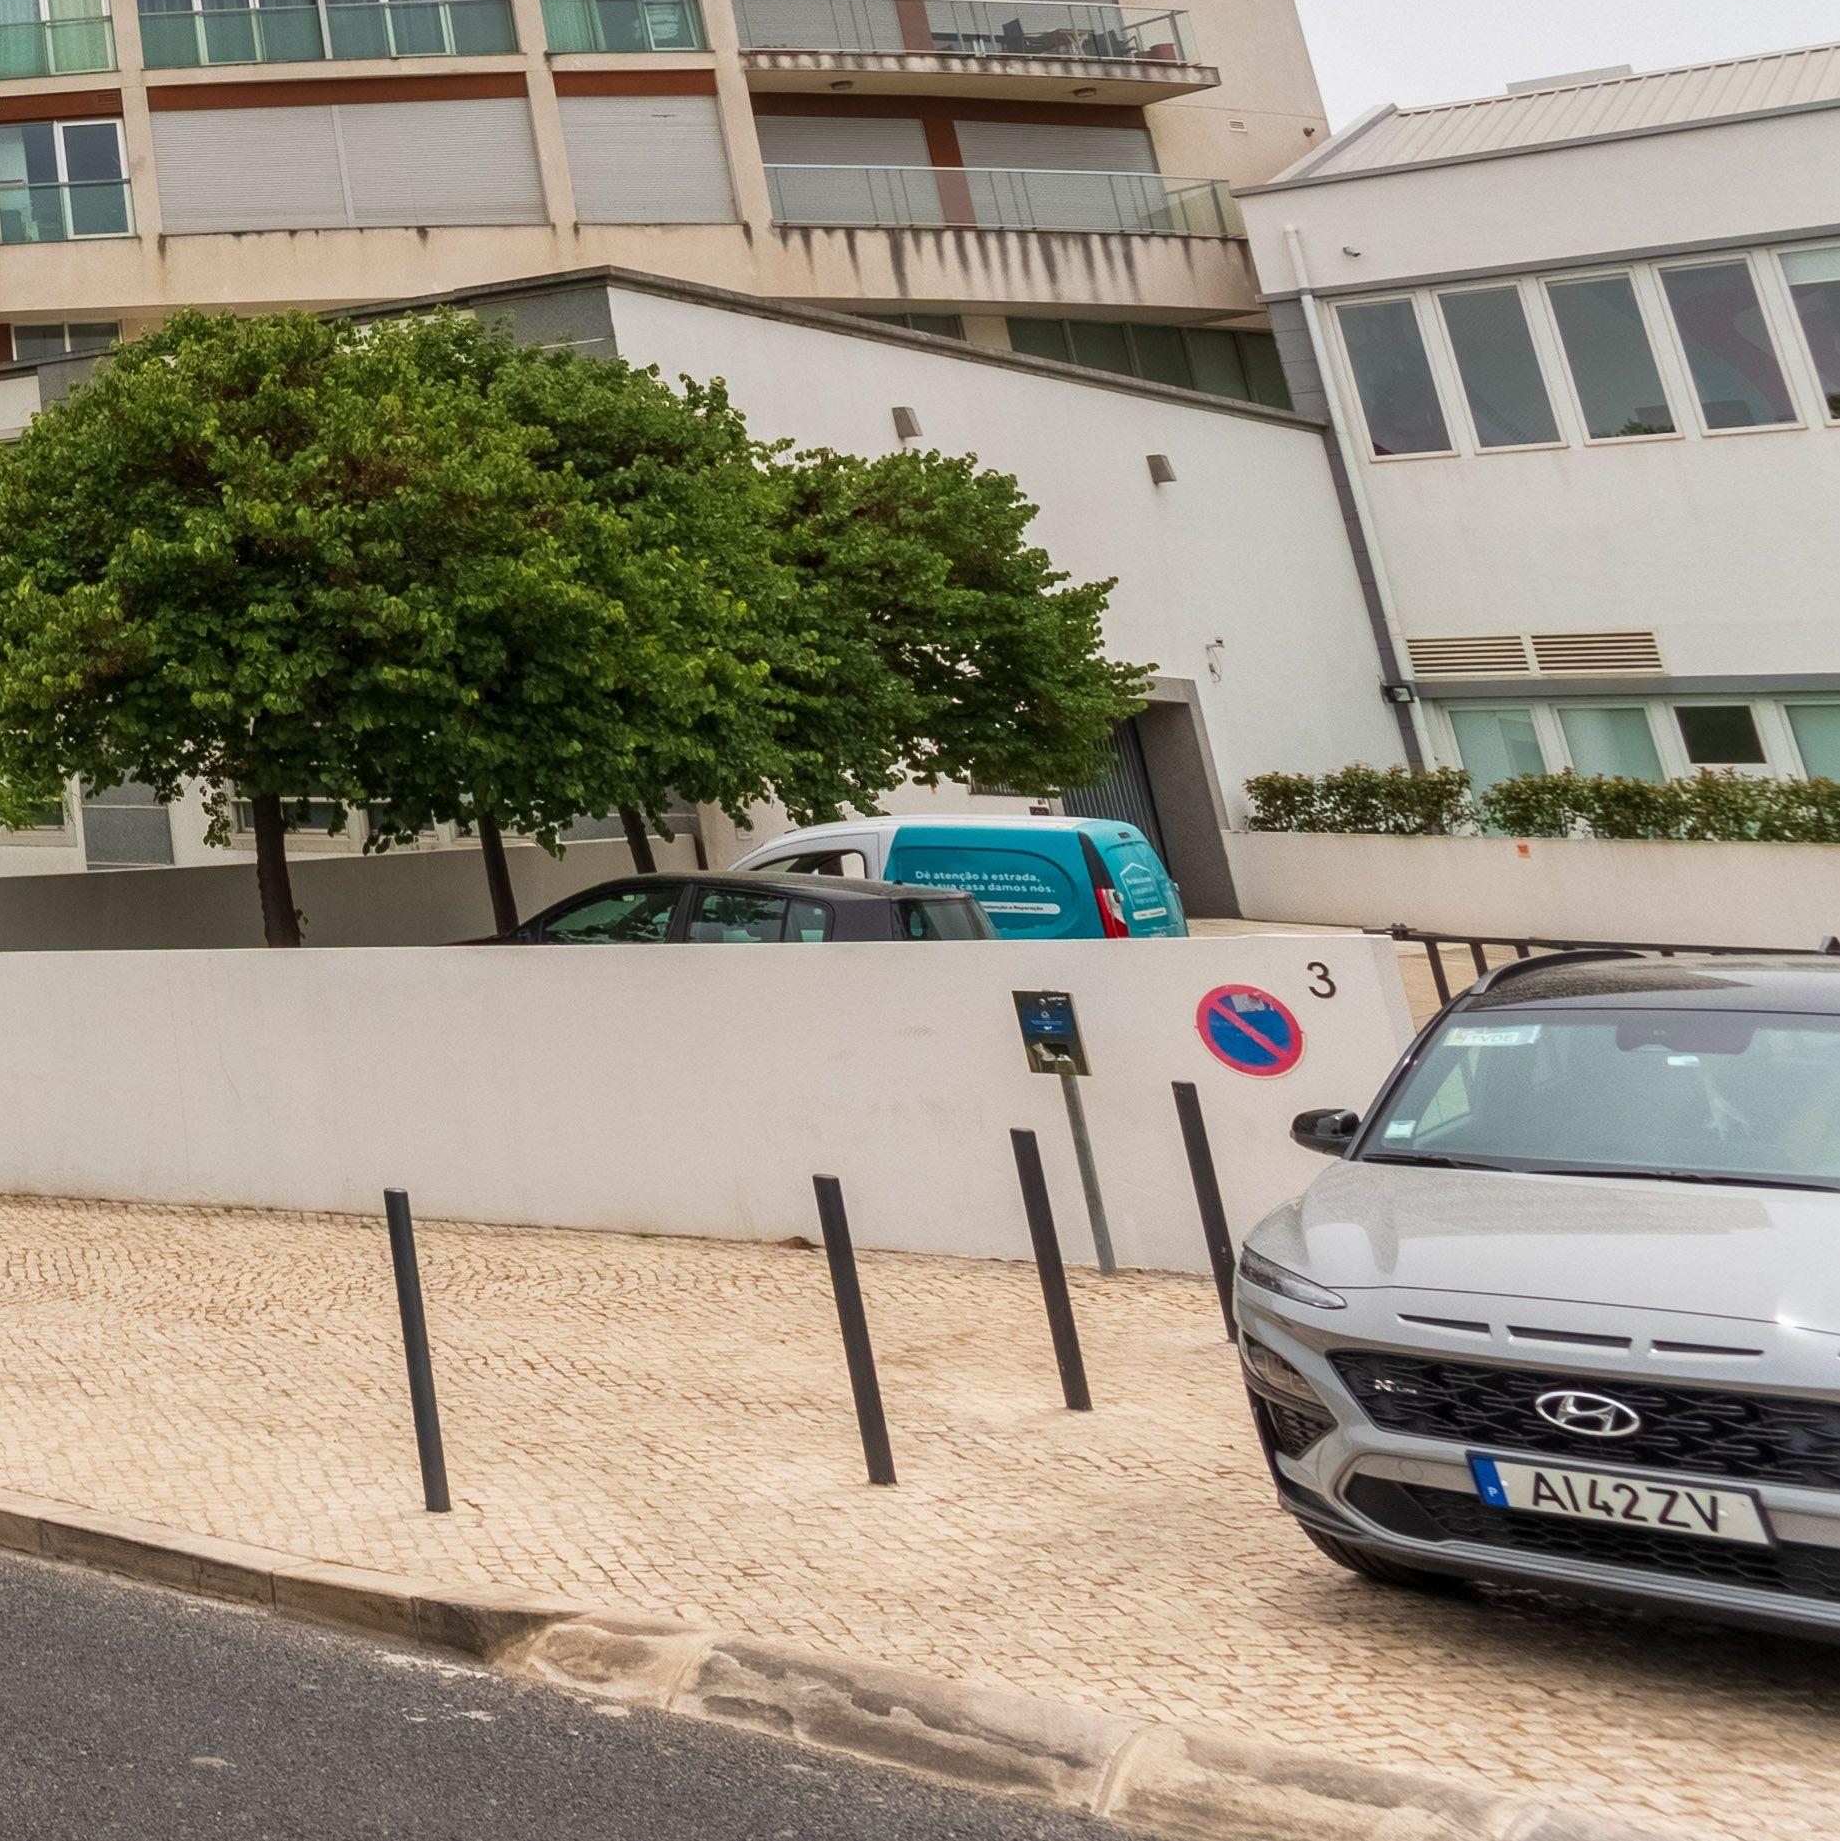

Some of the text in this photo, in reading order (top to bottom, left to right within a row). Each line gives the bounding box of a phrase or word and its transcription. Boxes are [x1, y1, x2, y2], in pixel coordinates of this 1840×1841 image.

[915, 870, 931, 880] Dê
[933, 871, 979, 883] atenção
[991, 872, 1041, 883] estrada,
[959, 884, 986, 892] casa
[988, 883, 1027, 893] damos
[1029, 883, 1056, 893] nós.
[1307, 961, 1336, 999] 3
